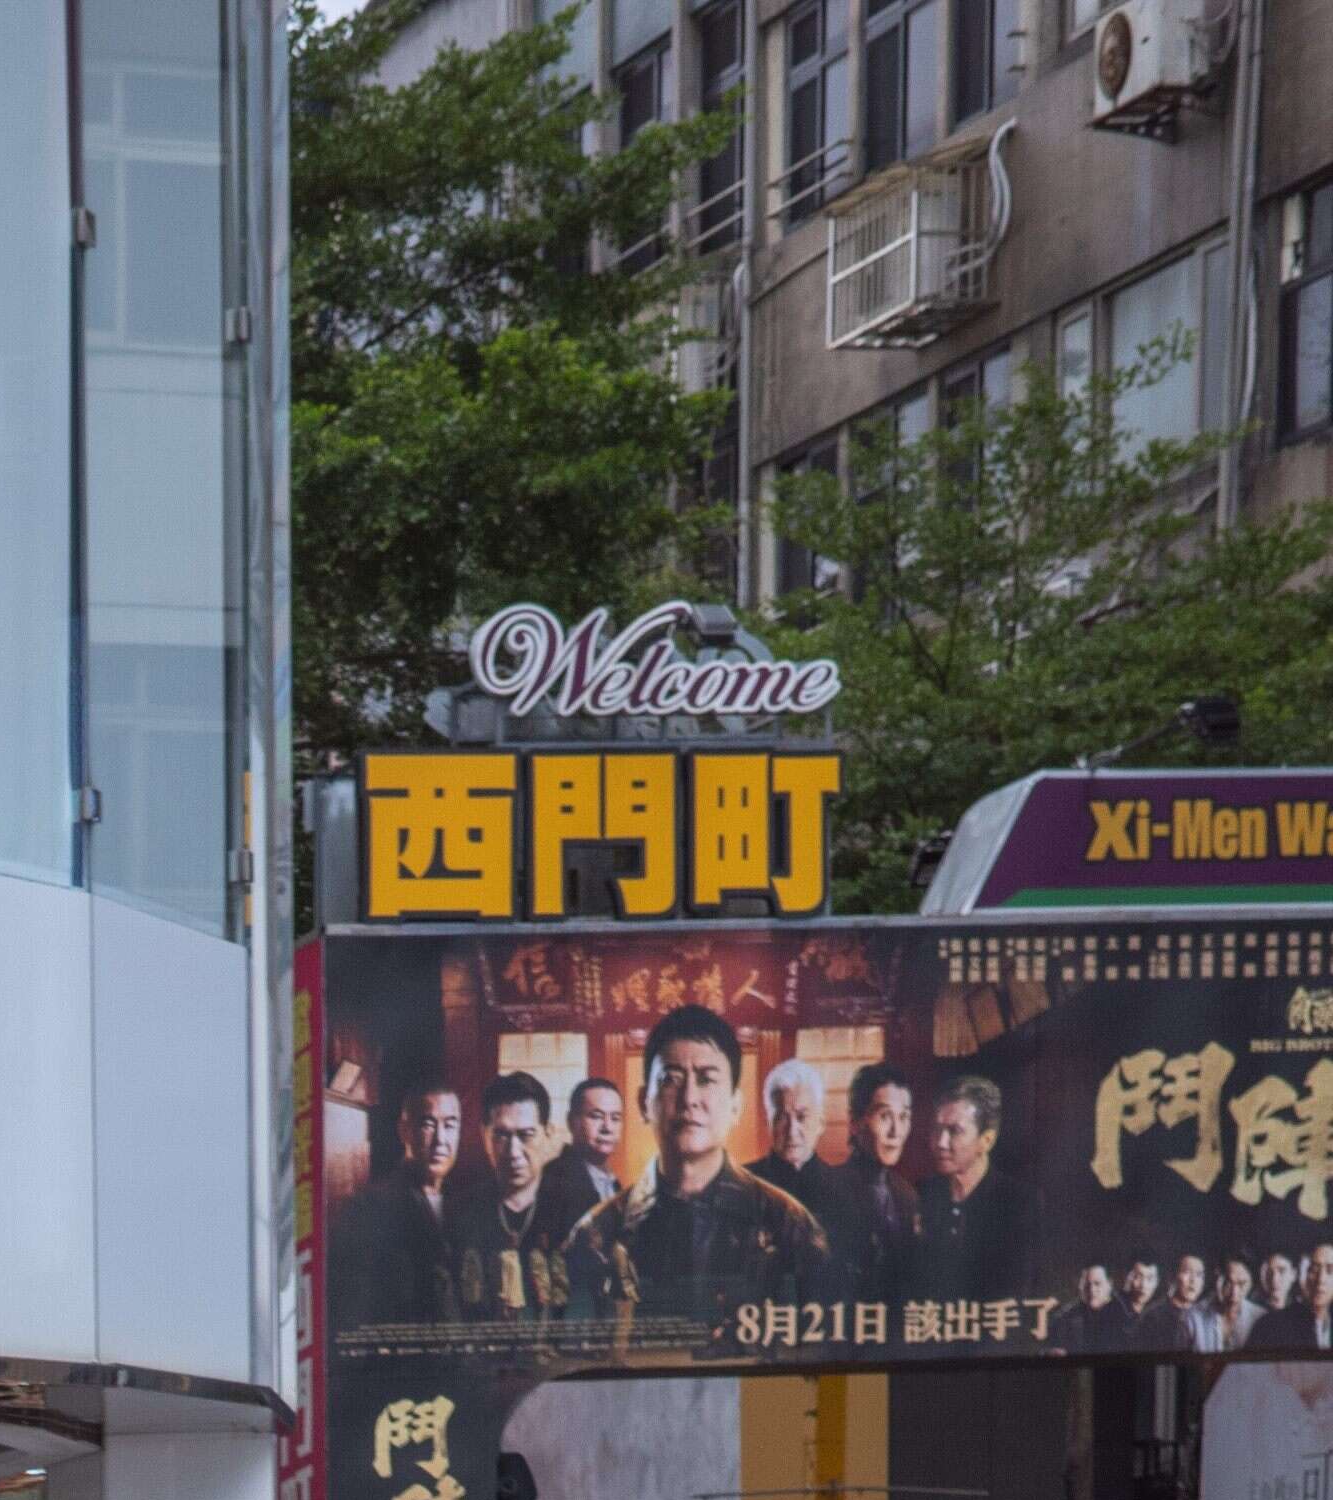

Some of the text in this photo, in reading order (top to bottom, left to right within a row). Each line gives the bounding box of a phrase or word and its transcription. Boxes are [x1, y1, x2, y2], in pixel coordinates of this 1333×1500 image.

[469, 599, 841, 717] Welcome
[363, 750, 843, 920] 西門町
[1085, 798, 1333, 861] Xi-Men W
[736, 1298, 886, 1347] 8月21日
[903, 1295, 1060, 1343] 該出手了
